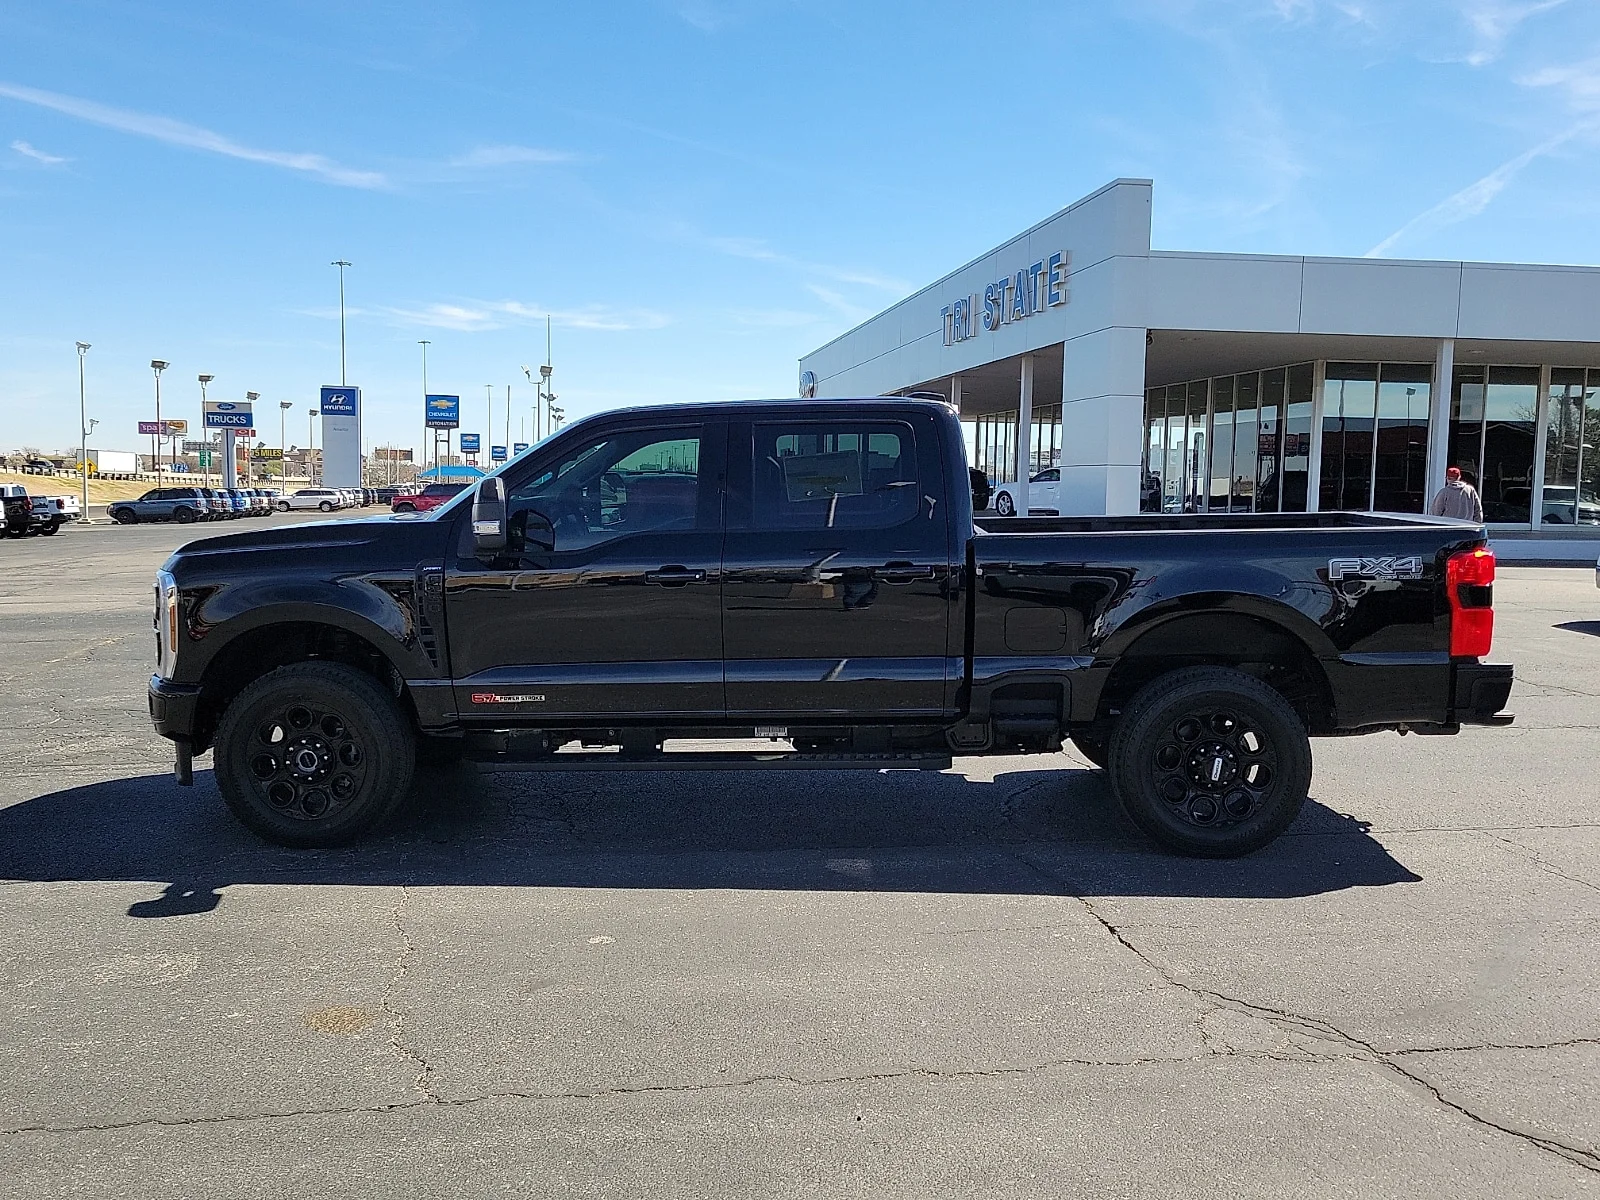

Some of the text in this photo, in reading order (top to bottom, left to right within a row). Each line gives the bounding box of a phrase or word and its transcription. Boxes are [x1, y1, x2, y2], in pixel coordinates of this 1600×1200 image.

[940, 250, 1068, 346] TRI STATE
[207, 414, 247, 424] TRUCKS
[142, 423, 165, 432] spak
[260, 449, 282, 457] MILES
[1328, 556, 1424, 581] FX4
